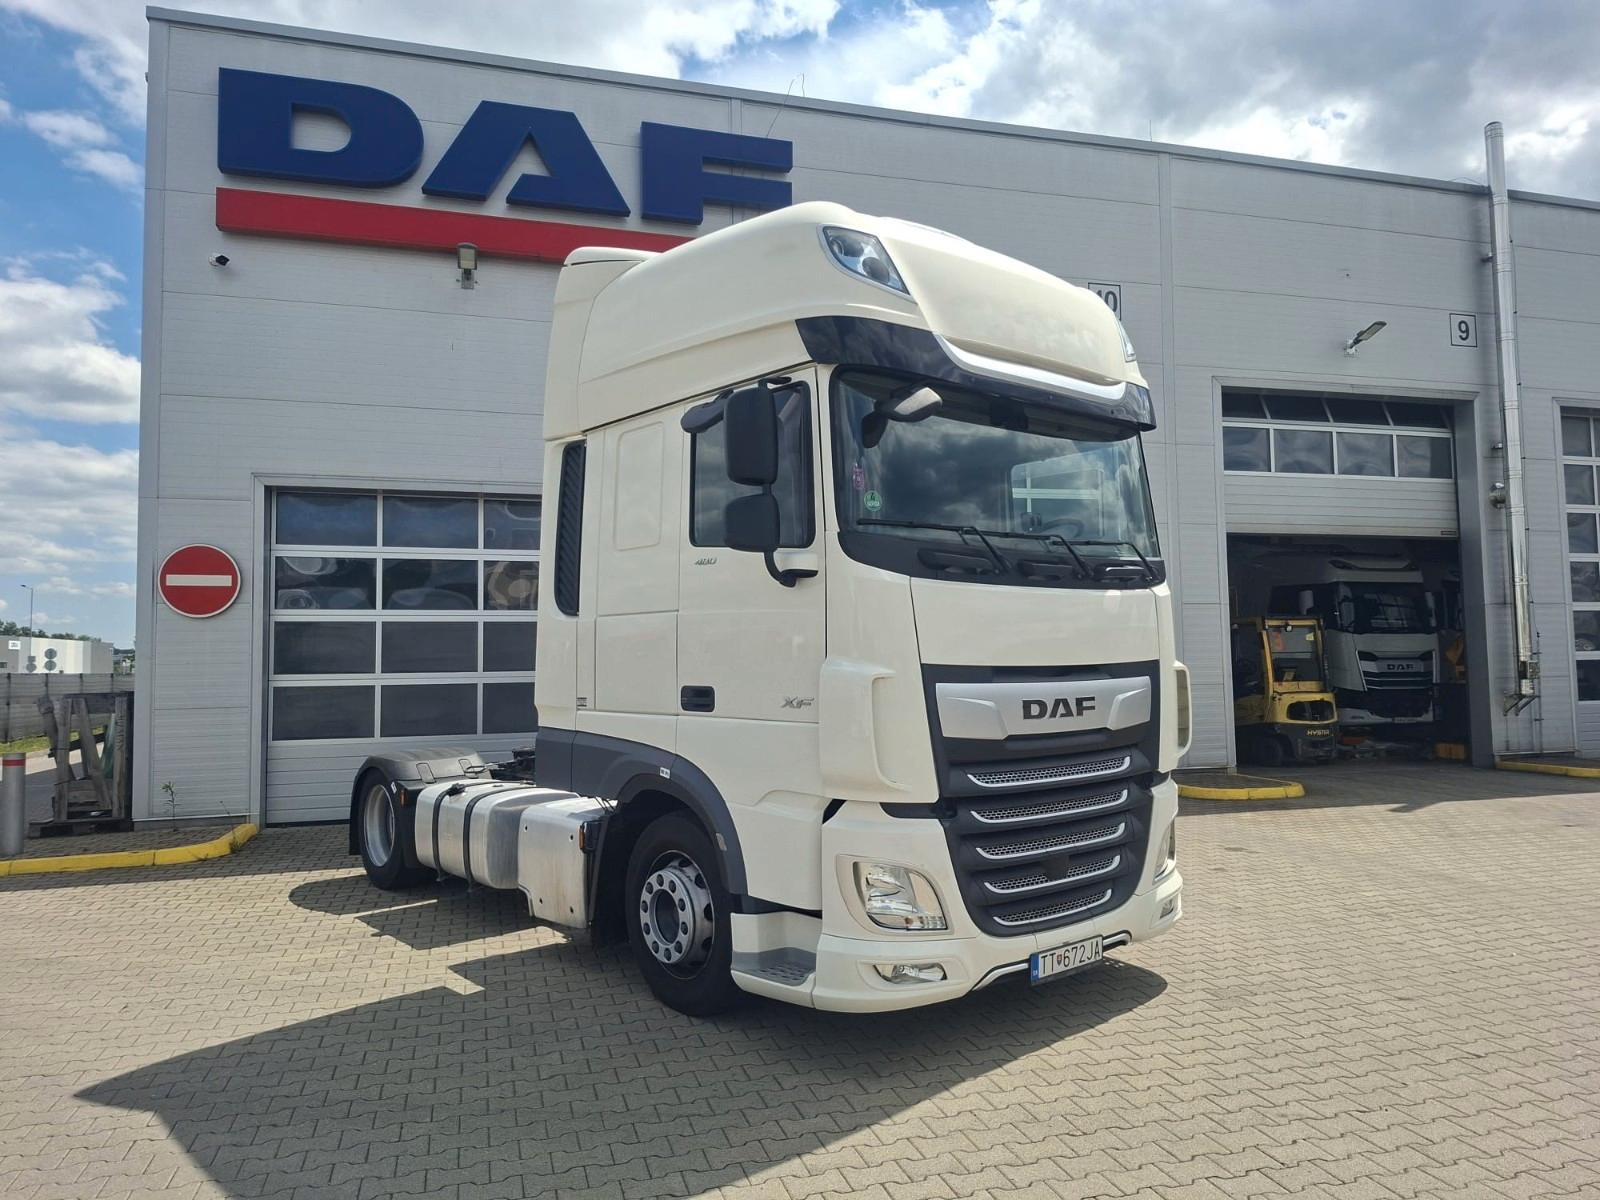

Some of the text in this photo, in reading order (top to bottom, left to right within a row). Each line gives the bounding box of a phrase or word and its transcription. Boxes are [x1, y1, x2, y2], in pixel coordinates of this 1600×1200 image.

[218, 67, 793, 225] DAF
[1096, 290, 1118, 313] 0
[1458, 320, 1470, 341] 9
[1386, 663, 1416, 671] DAF
[1022, 696, 1096, 720] DAF
